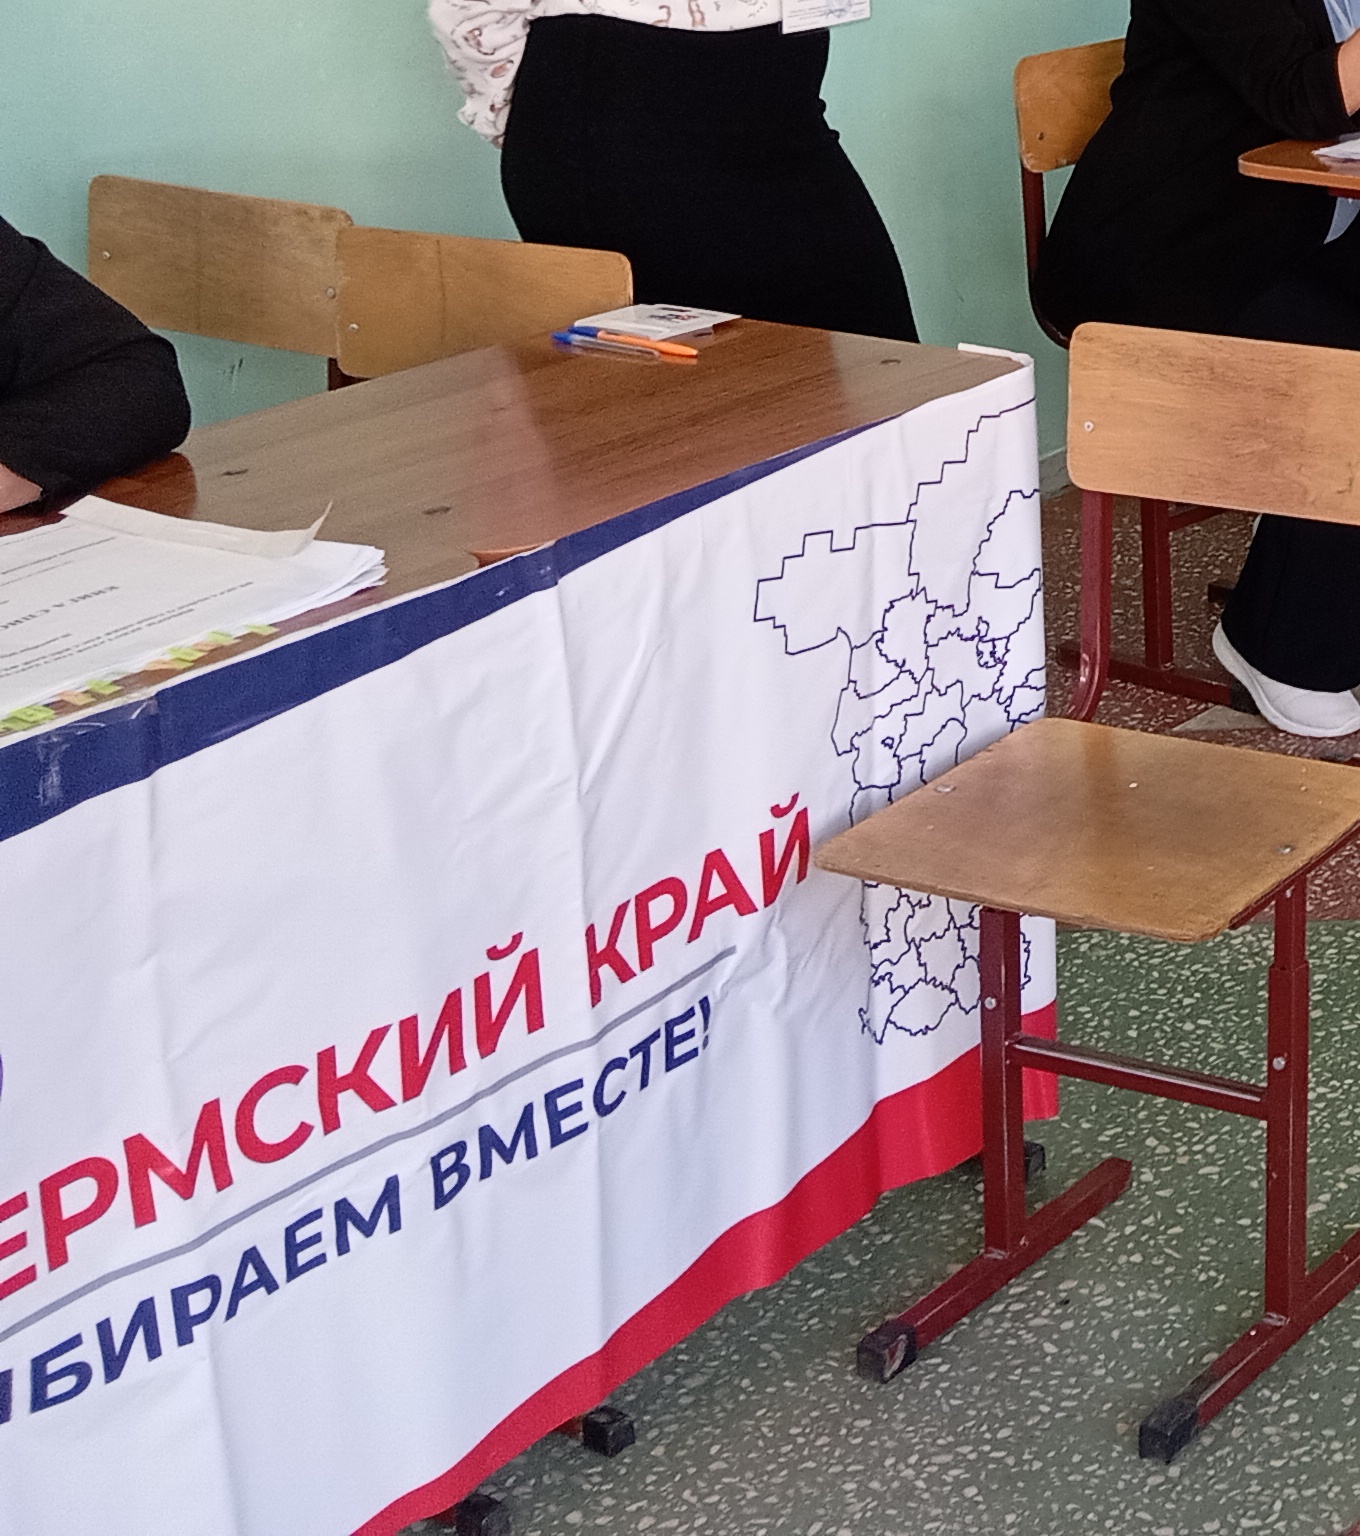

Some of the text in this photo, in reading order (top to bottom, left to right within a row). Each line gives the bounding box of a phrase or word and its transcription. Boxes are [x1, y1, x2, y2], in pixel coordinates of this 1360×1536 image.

[0, 791, 813, 1302] ЕРМСКИЙ КРАЙ
[429, 996, 712, 1210] ВМЕСТЕ!
